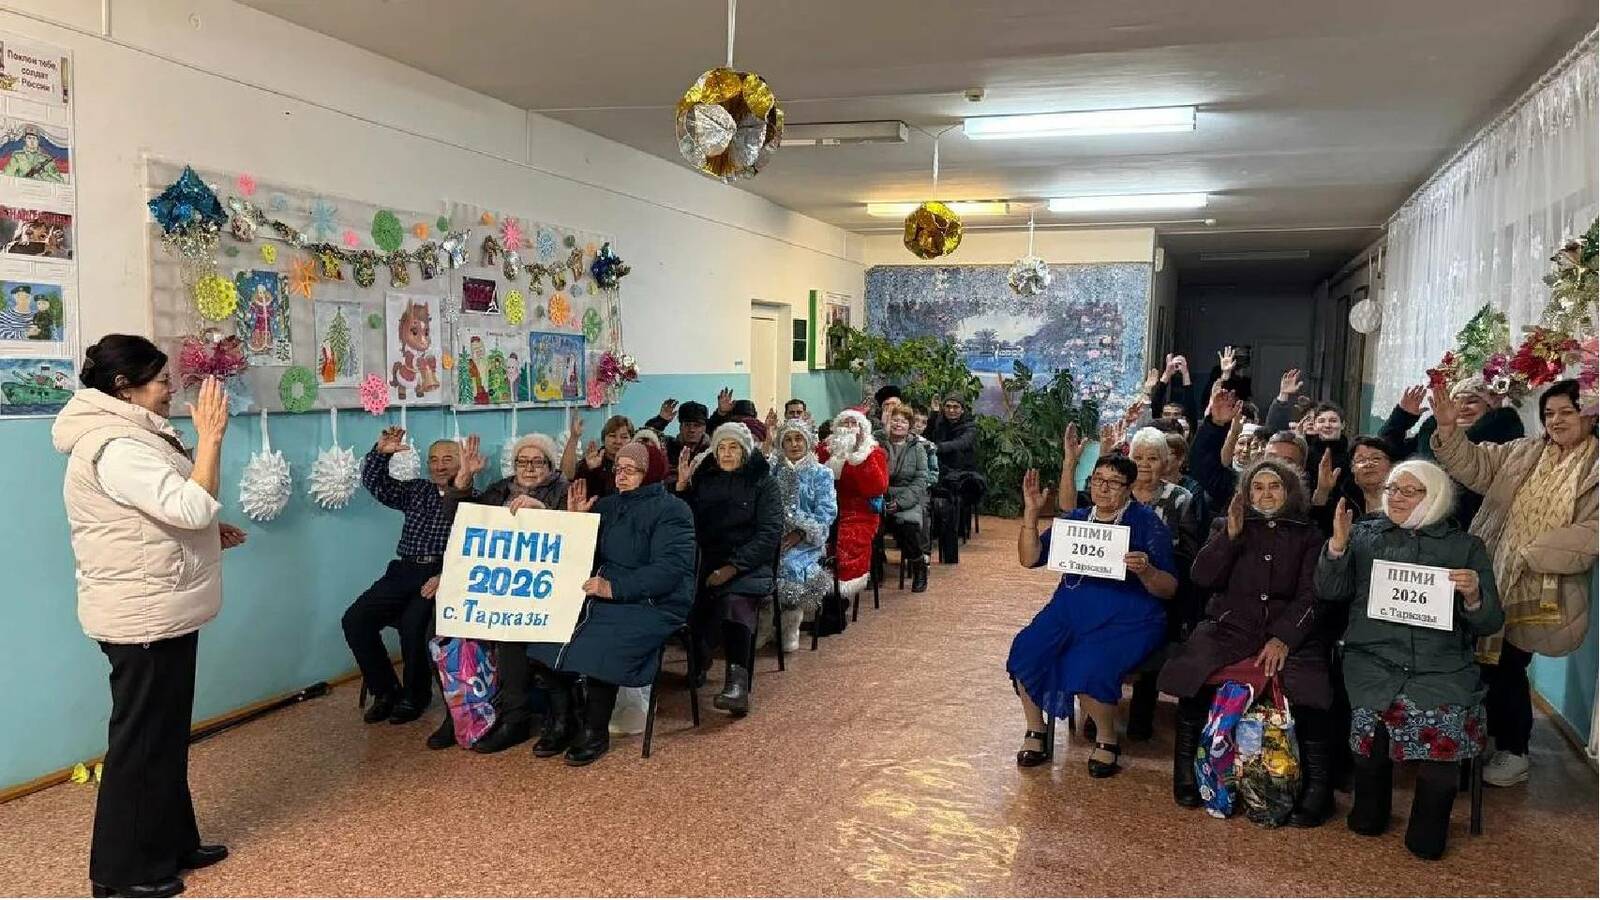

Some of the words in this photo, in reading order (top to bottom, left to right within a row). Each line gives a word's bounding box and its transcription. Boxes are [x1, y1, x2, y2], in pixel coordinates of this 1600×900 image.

[21, 67, 49, 80] солдат
[21, 78, 50, 91] России
[1067, 526, 1112, 541] ППМИ
[462, 527, 561, 563] ППМИ
[1071, 543, 1104, 558] 2026
[1068, 561, 1112, 574] Тарказы
[467, 565, 553, 599] 2026
[1388, 569, 1435, 585] ППМИ
[1392, 588, 1427, 604] 2026
[443, 606, 457, 619] с.
[463, 600, 549, 629] Тарказы
[1380, 607, 1389, 616] с.
[1389, 607, 1437, 622] Тарказы
